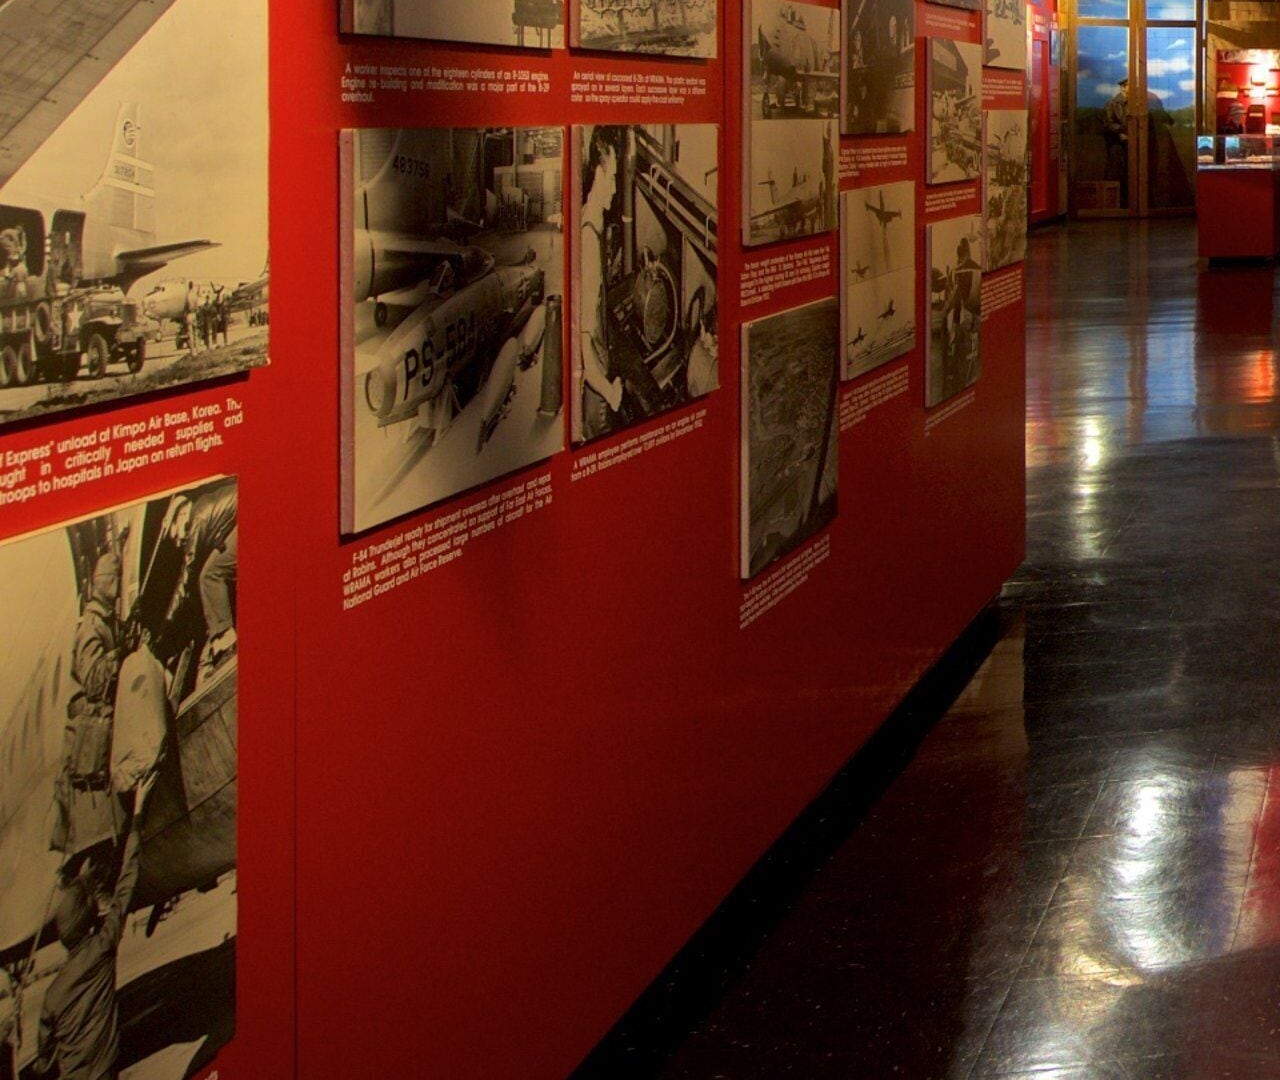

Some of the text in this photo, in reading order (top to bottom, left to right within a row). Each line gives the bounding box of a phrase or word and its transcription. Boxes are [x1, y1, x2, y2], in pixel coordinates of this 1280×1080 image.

[41, 461, 51, 475] in
[65, 445, 111, 469] critically
[124, 431, 164, 453] needed
[176, 421, 213, 440] supplies
[225, 411, 243, 427] and
[58, 430, 96, 453] unload
[100, 427, 110, 443] at
[113, 422, 145, 439] Kimpo
[149, 416, 161, 430] Air
[39, 479, 51, 494] to
[53, 466, 101, 490] hospitals
[104, 462, 113, 476] in
[117, 455, 148, 472] Japan
[152, 451, 163, 463] on
[166, 443, 193, 459] return
